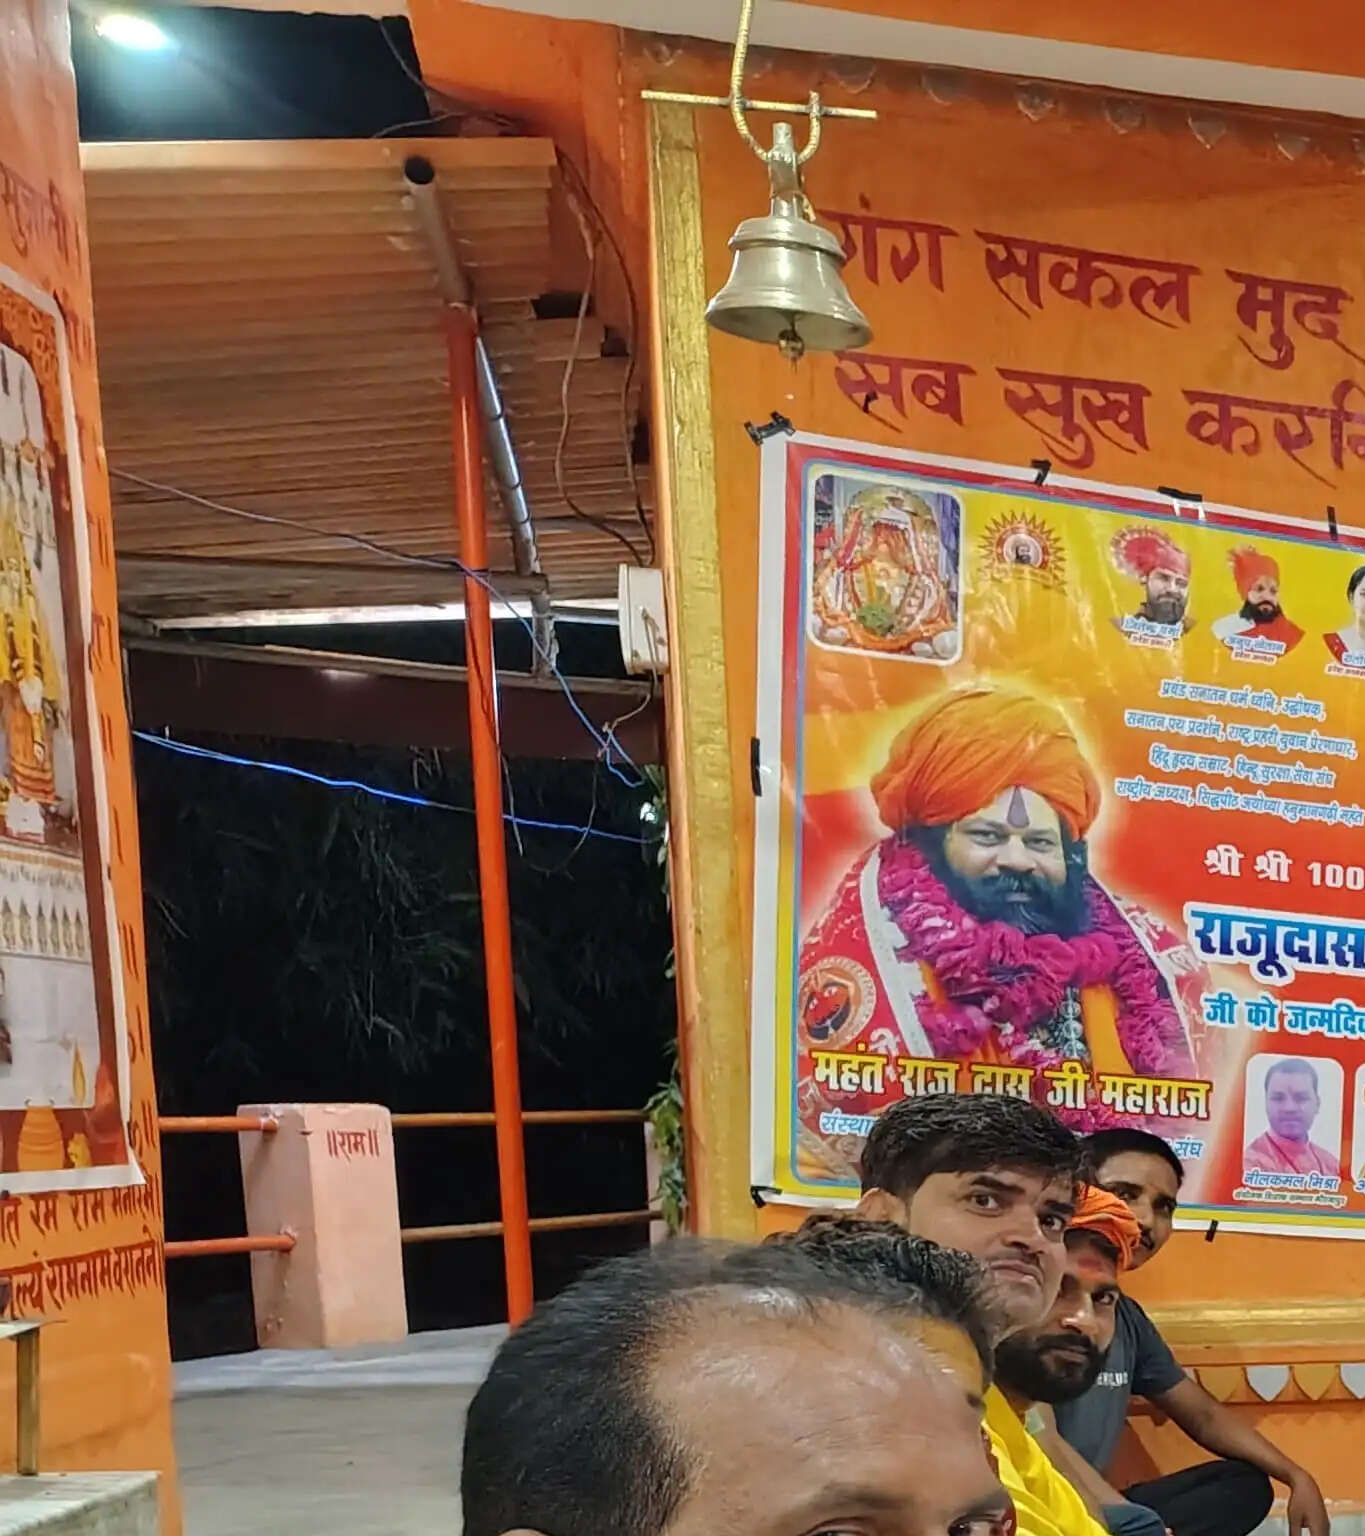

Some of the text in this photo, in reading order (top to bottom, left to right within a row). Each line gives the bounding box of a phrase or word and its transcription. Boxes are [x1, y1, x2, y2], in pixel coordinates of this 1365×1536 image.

[975, 228, 1204, 330] सकल
[834, 350, 977, 434] सब
[995, 367, 1152, 471] सुख
[1203, 843, 1243, 878] श्री
[1253, 848, 1293, 884] श्री
[1203, 992, 1237, 1026] जी
[1246, 995, 1279, 1029] को
[808, 1042, 888, 1095] महंत
[898, 1058, 961, 1096] राज
[1043, 1059, 1093, 1111] जी
[1100, 1072, 1214, 1120] महाराज
